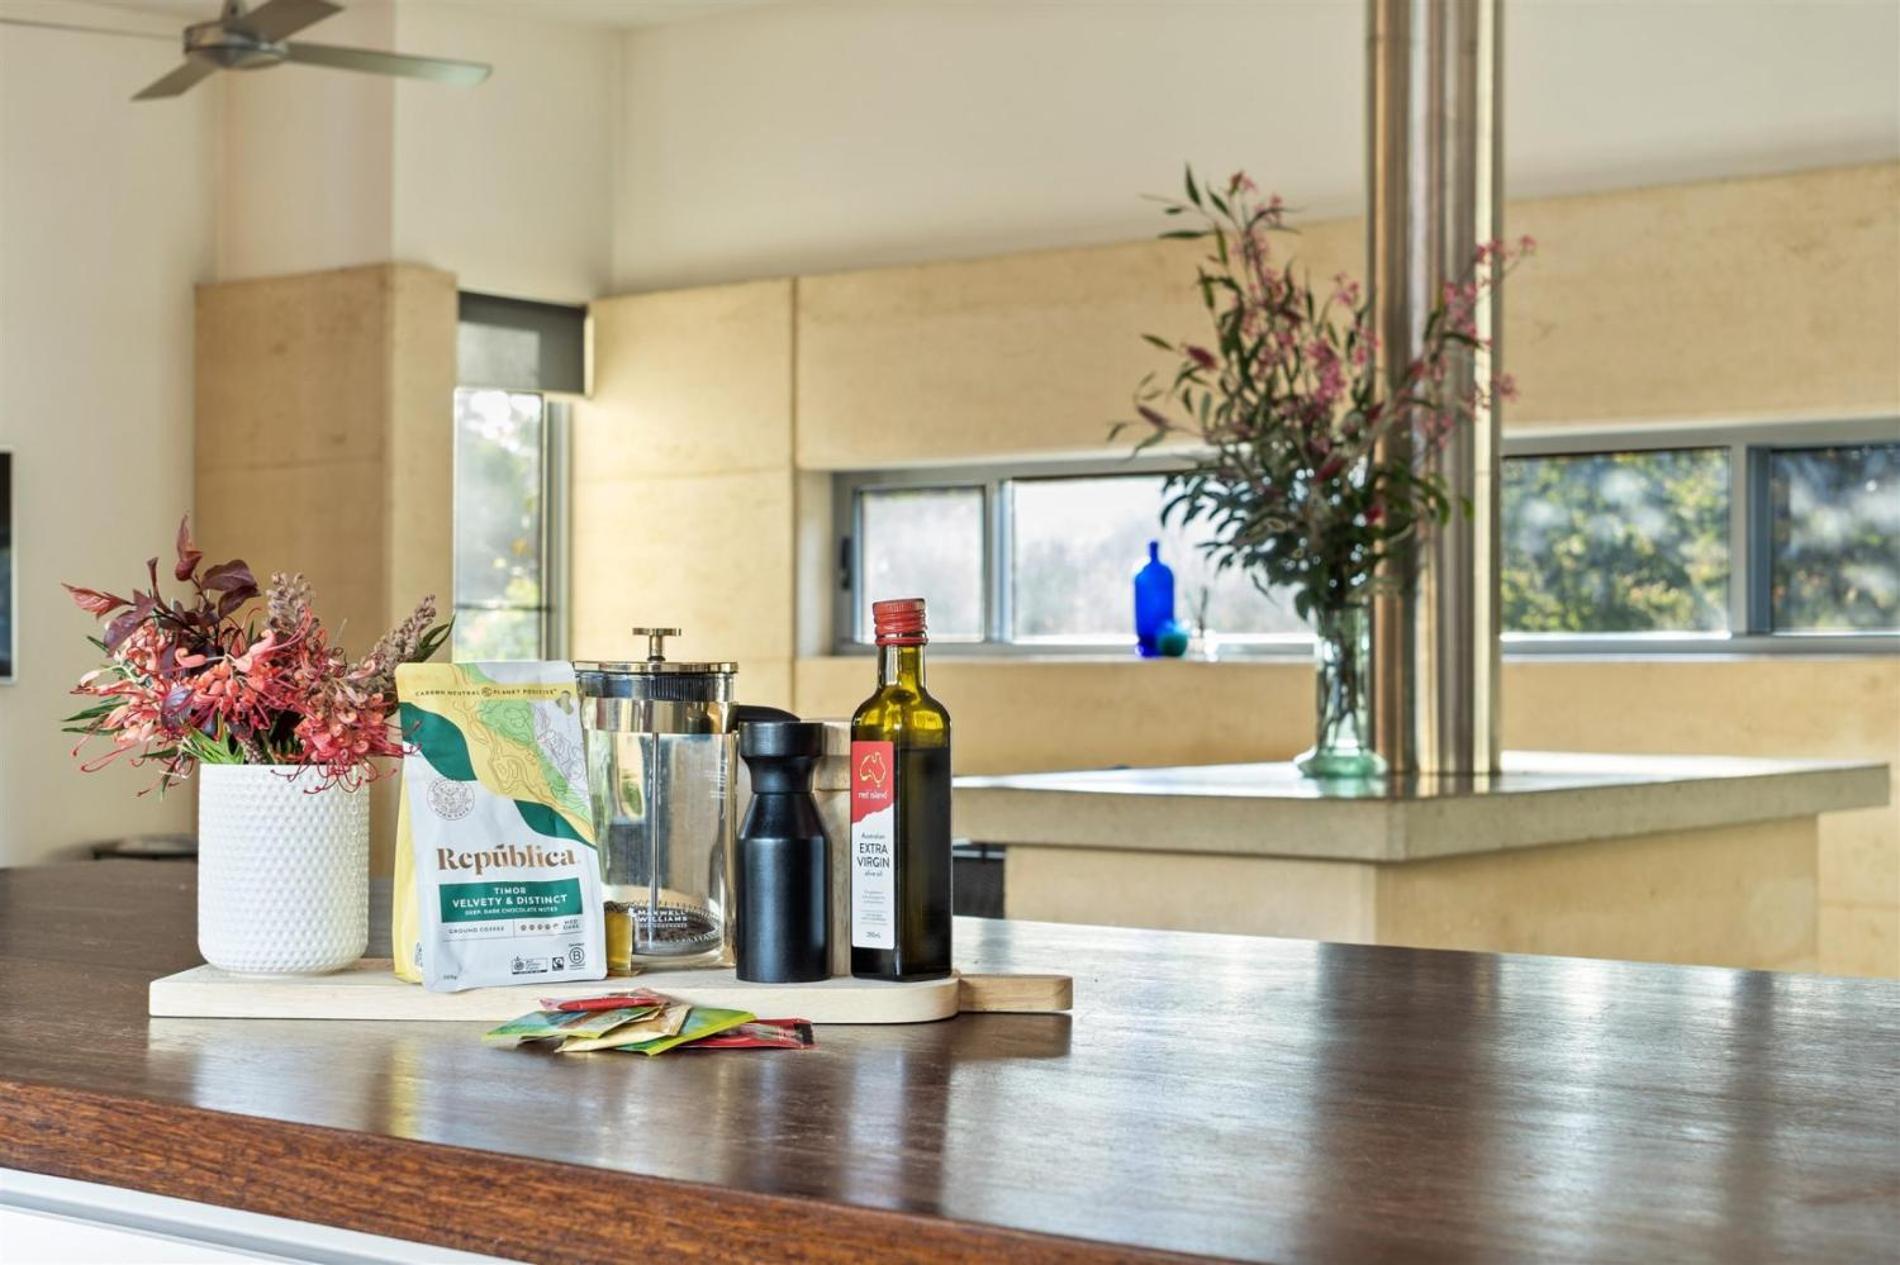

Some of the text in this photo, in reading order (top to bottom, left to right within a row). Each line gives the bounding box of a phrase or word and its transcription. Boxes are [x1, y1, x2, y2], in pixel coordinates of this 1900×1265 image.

[859, 843, 888, 854] EXTRA
[437, 843, 576, 875] República
[857, 857, 890, 868] VIRGIN
[493, 886, 527, 895] TIMOR
[452, 894, 568, 908] VELVETY & DISTINCT
